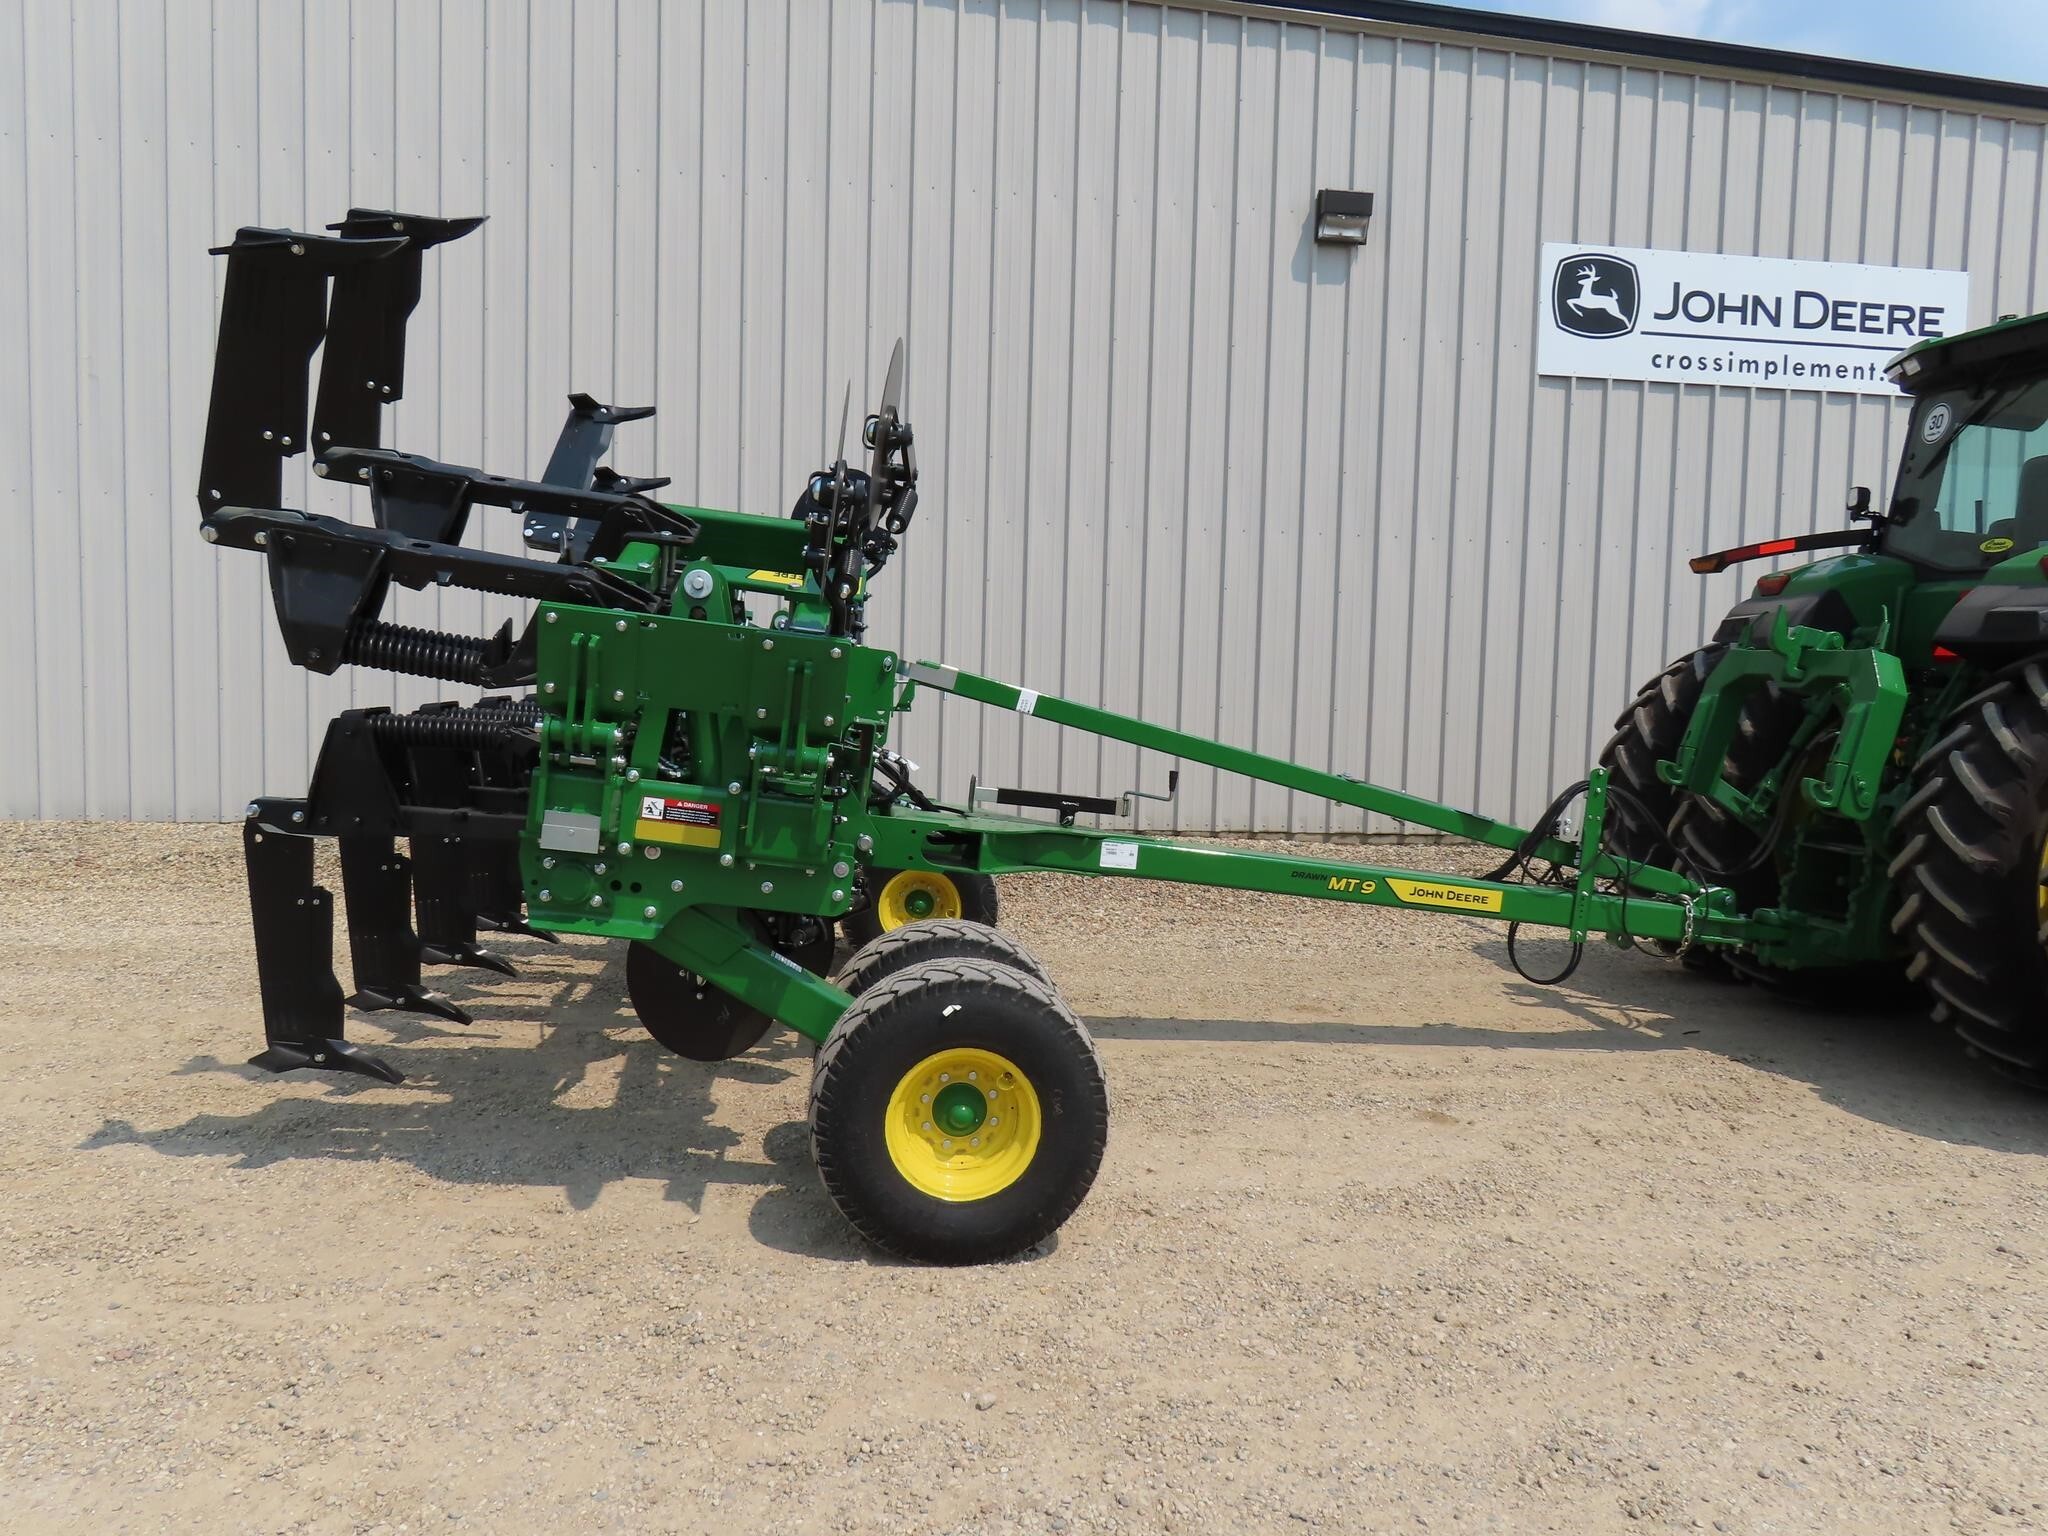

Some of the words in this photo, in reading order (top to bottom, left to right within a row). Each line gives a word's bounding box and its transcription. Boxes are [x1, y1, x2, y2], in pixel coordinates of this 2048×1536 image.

[1653, 281, 1782, 328] JOHN
[1792, 290, 1945, 338] DEERE
[1651, 351, 1886, 381] crossimplement.
[1929, 413, 1944, 431] 30
[683, 801, 708, 810] DANGER
[1291, 870, 1328, 881] DRAWN
[1409, 886, 1444, 899] JOHN
[1446, 890, 1489, 905] DEERE
